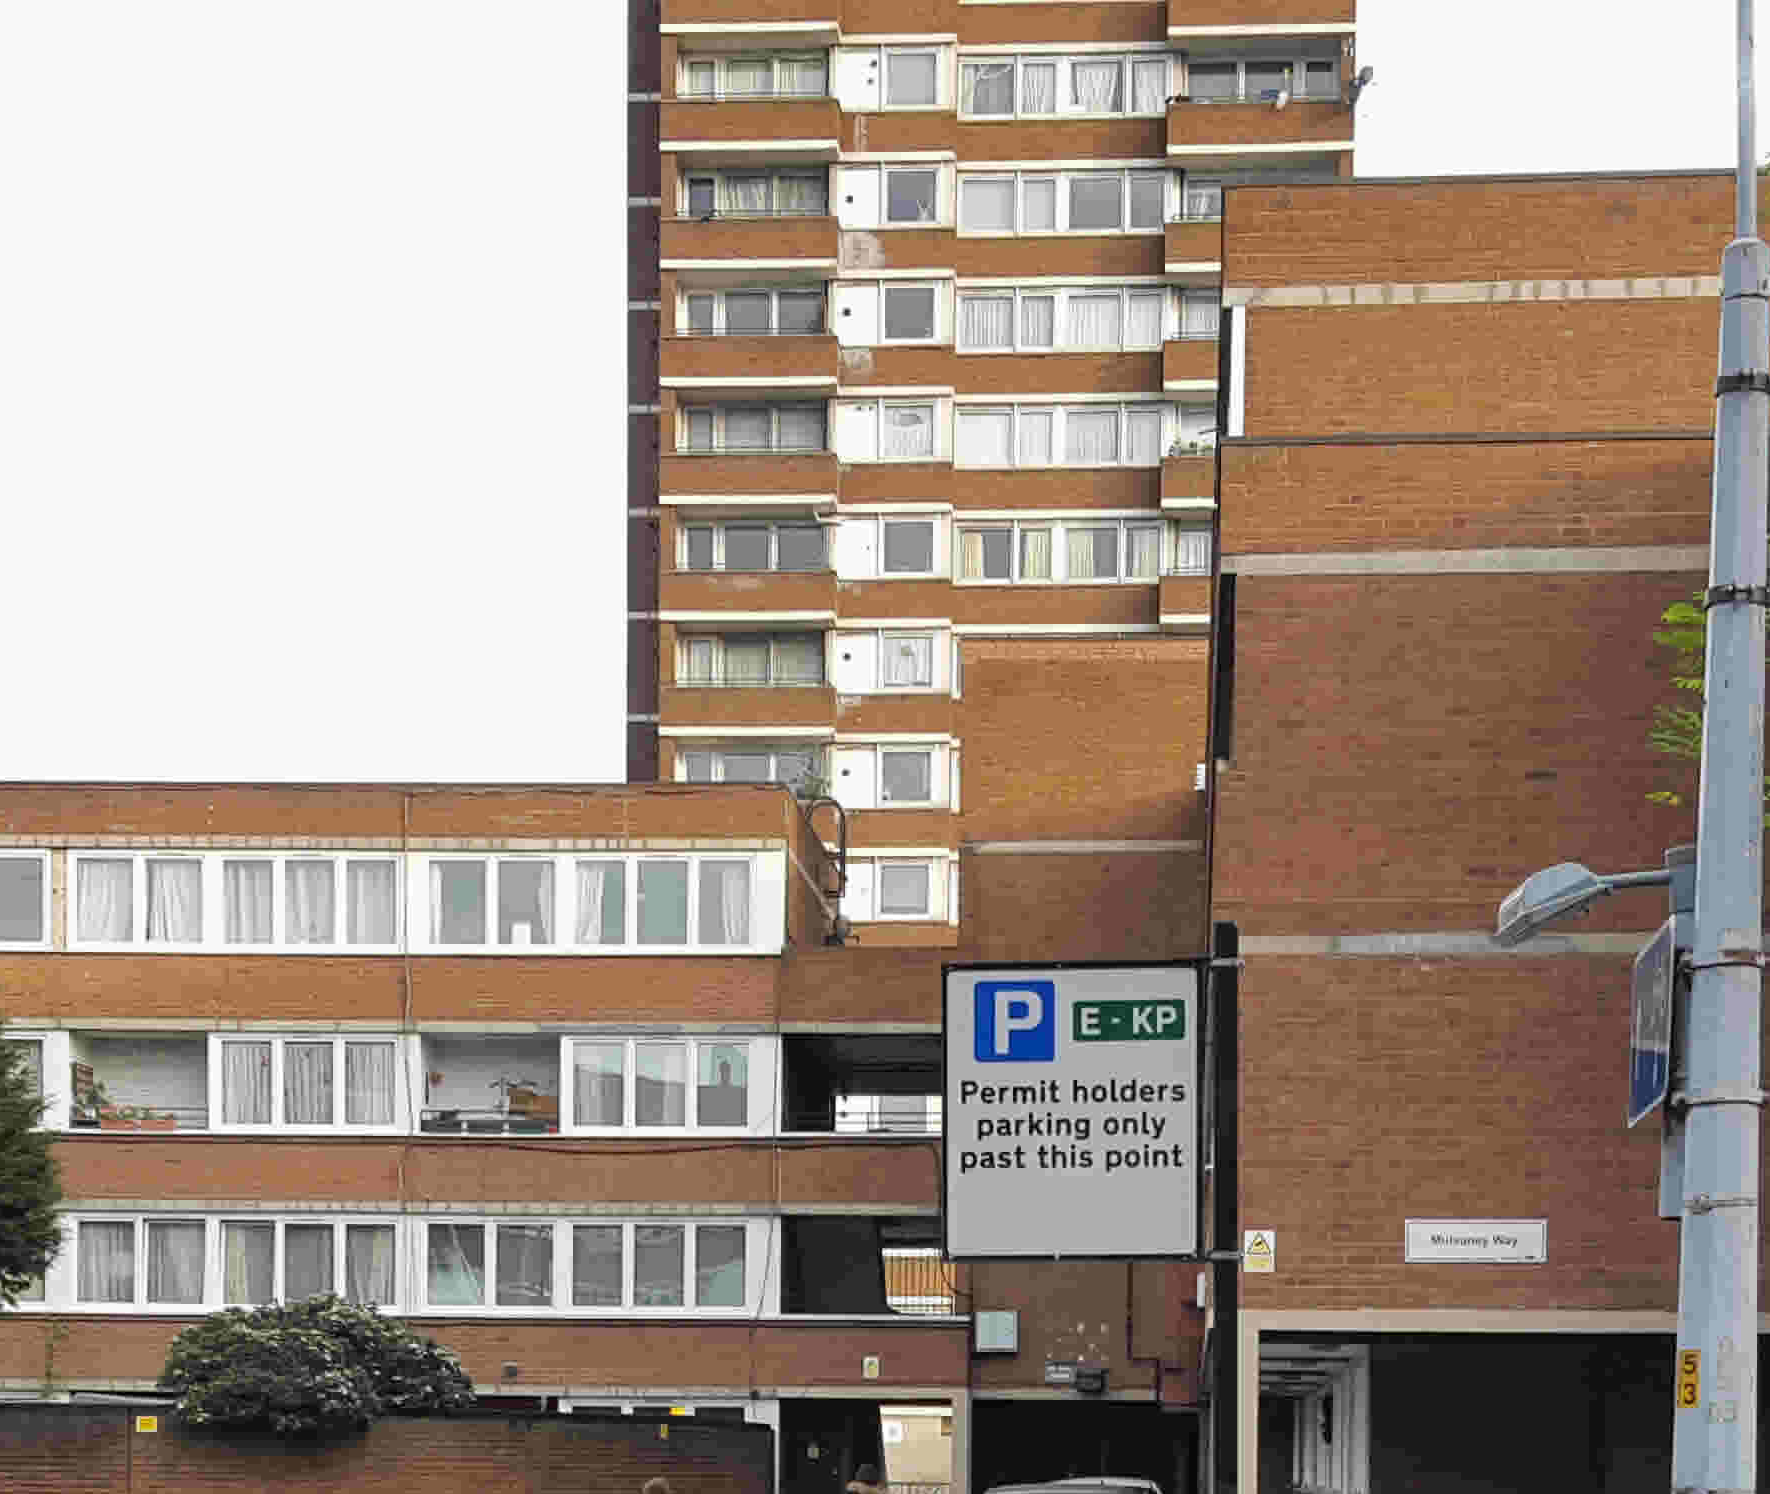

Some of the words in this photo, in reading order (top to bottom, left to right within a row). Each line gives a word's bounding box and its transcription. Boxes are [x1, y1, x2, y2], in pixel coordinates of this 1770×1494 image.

[994, 991, 1044, 1056] P
[1080, 1007, 1102, 1036] E
[1131, 1005, 1178, 1034] KP
[960, 1079, 1060, 1104] Permit
[1072, 1078, 1186, 1103] holders
[977, 1112, 1091, 1141] parking
[1102, 1112, 1166, 1139] only
[960, 1145, 1026, 1175] past
[1037, 1144, 1094, 1169] this
[1105, 1144, 1183, 1173] point
[1492, 1232, 1518, 1249] Way
